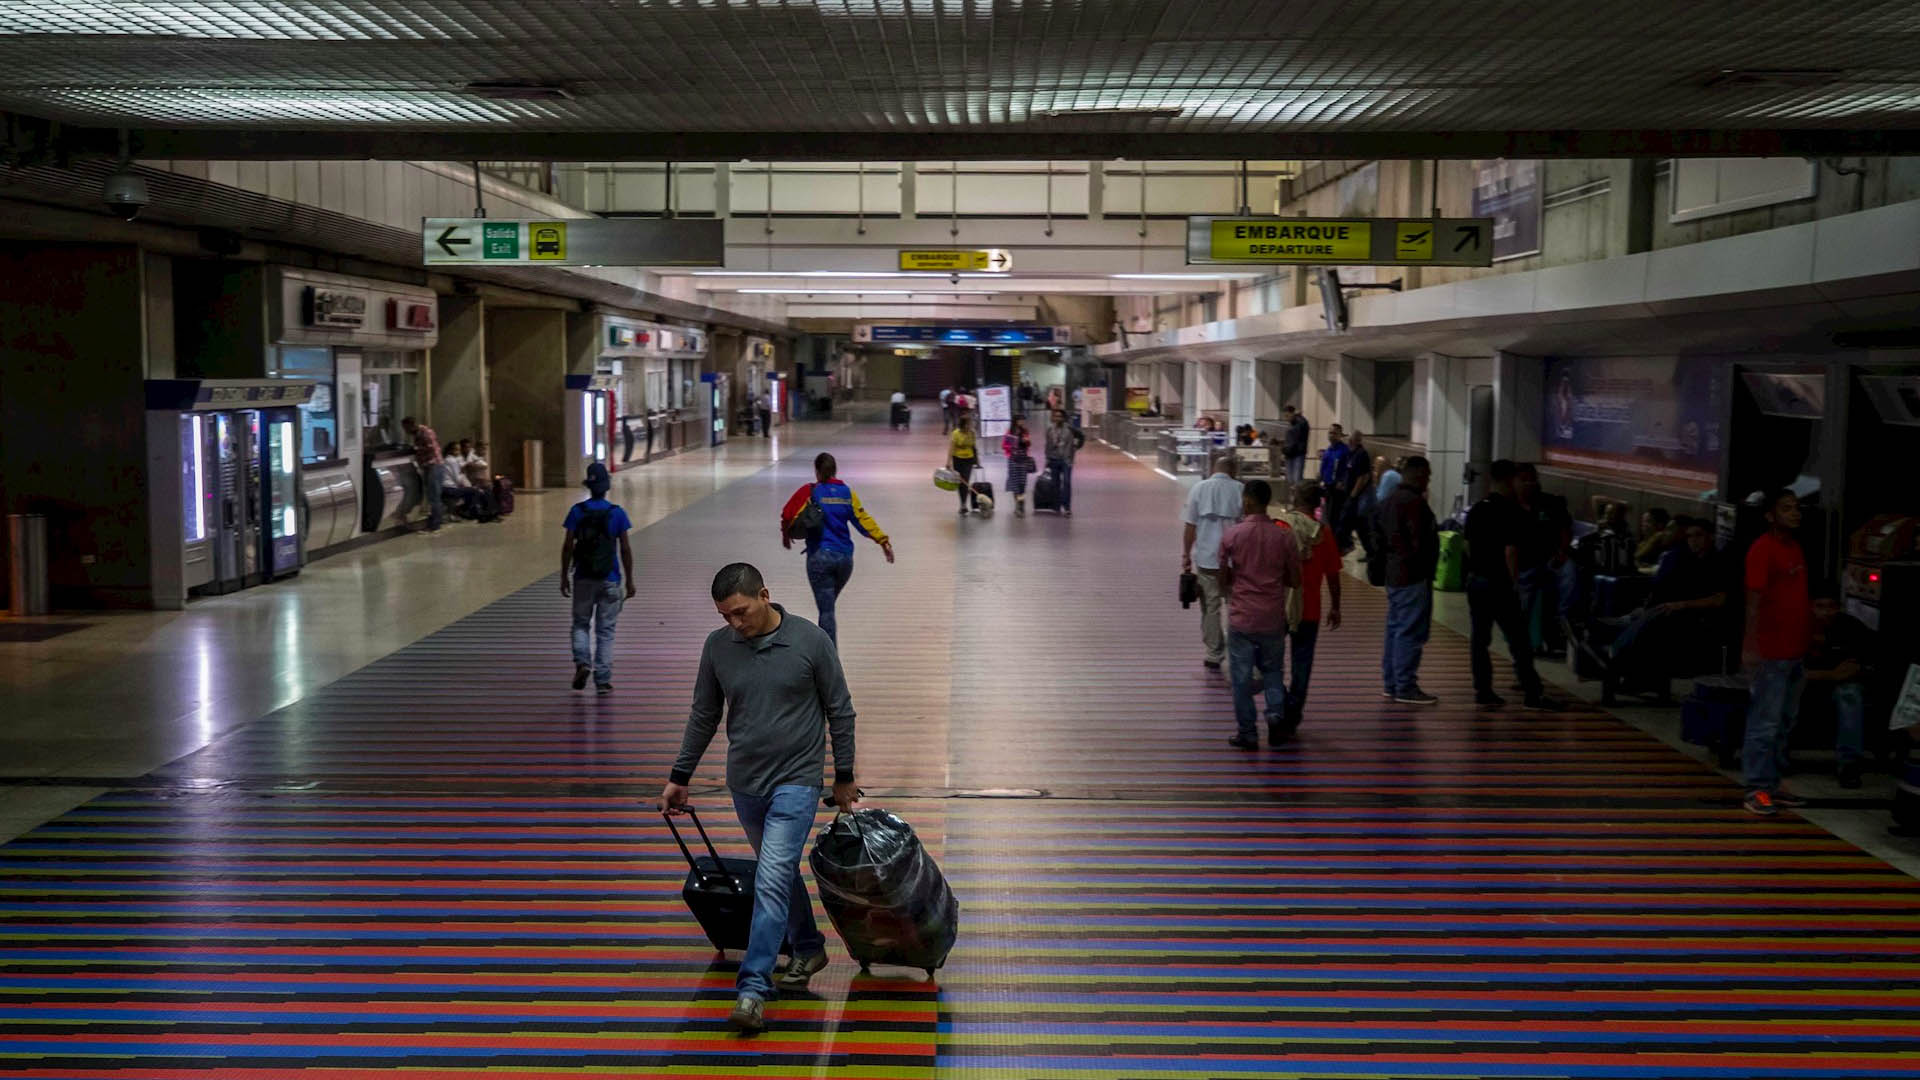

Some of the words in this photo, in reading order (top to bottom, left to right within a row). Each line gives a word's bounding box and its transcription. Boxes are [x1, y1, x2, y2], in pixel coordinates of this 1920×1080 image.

[486, 228, 516, 239] Salida
[1235, 225, 1350, 240] EMBARQUE
[491, 243, 511, 254] Exit
[1249, 244, 1334, 255] DEPARTURE
